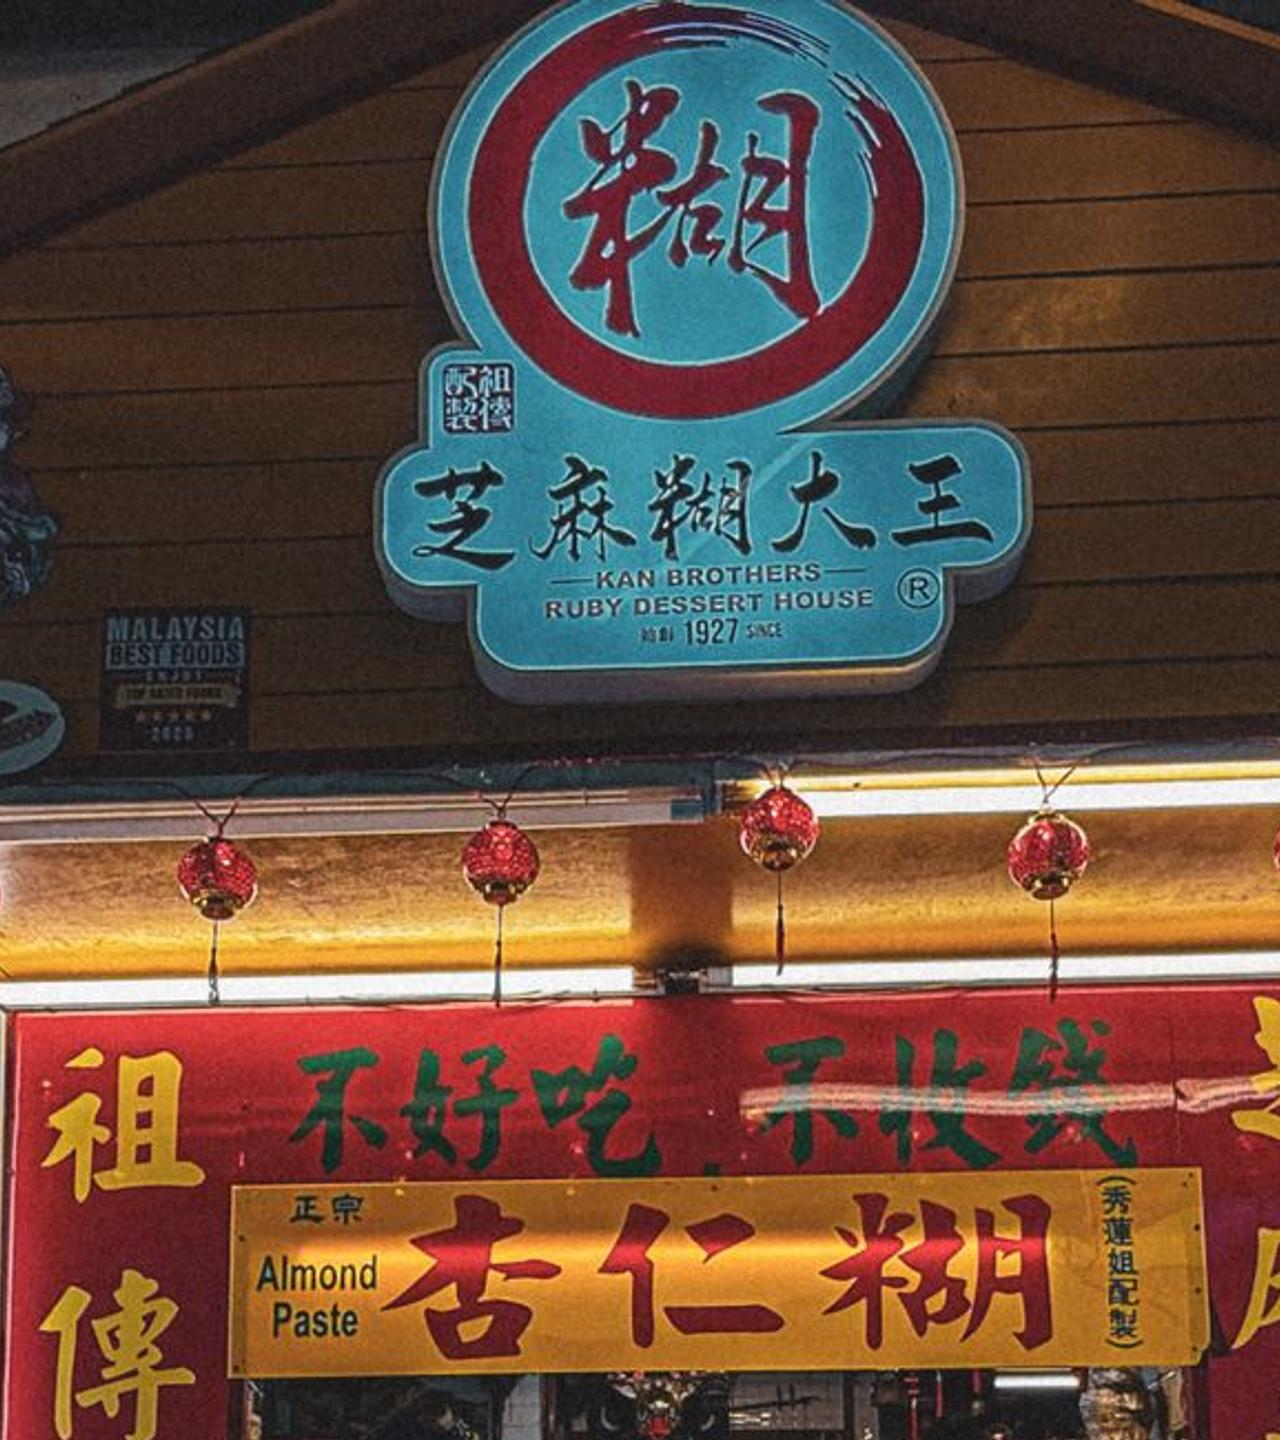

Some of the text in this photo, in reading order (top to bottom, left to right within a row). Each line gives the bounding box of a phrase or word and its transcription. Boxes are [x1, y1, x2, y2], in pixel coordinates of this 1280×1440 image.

[562, 79, 821, 337] 糊
[412, 452, 994, 570] 芝麻糊大王
[596, 563, 821, 590] KAN BROTHERS
[545, 589, 874, 619] RUBY DESSERT HOUSE
[106, 616, 245, 642] MALAYSIA
[684, 618, 738, 645] 1927
[746, 622, 784, 640] SINCE
[111, 643, 241, 665] BEST FOODS
[290, 1193, 365, 1228] 正宗
[257, 1252, 379, 1294] Almond
[381, 1191, 1053, 1363] 杏仁糊
[273, 1301, 360, 1340] Paste
